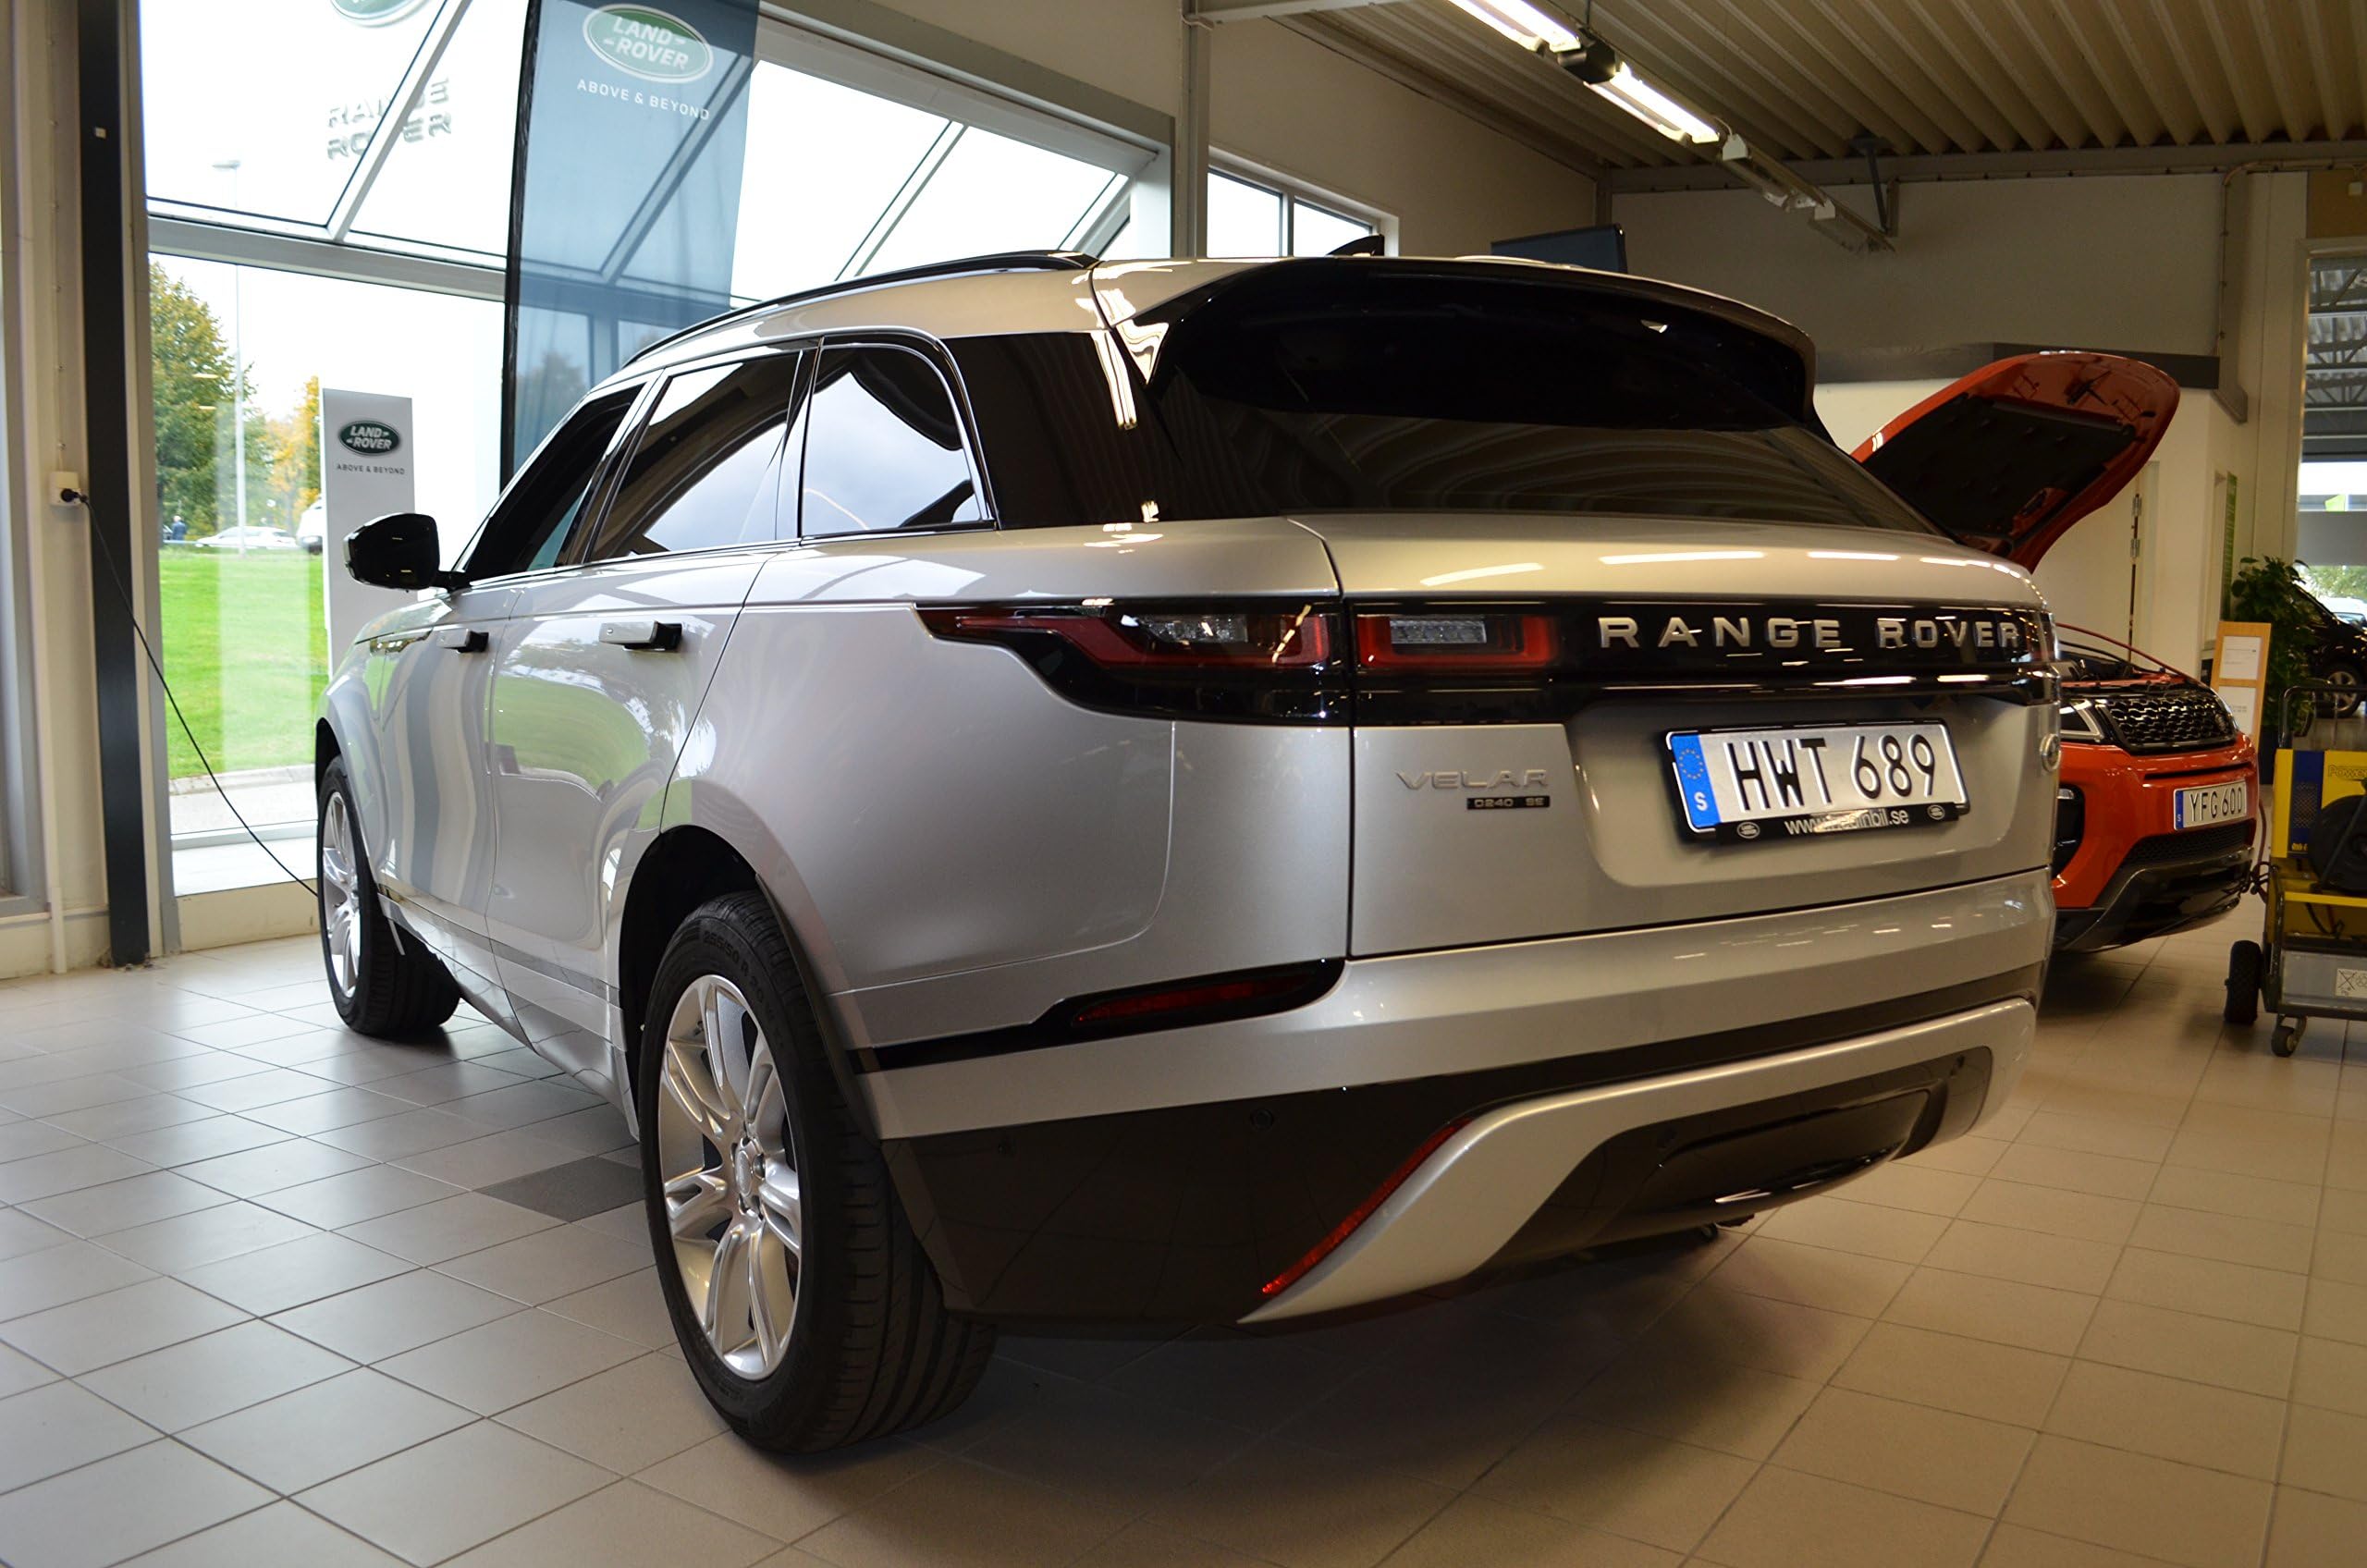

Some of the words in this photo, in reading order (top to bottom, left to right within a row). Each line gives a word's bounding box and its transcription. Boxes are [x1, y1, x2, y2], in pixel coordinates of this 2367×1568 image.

[577, 79, 630, 101] ABOVE
[634, 92, 644, 104] &
[649, 95, 710, 120] BEYOND
[327, 111, 452, 160] ROER
[337, 462, 363, 472] ABOVE
[365, 464, 372, 473] &
[373, 465, 406, 476] BEYOND
[1597, 616, 1843, 648] RANGE
[1875, 619, 2020, 649] ROVER
[1394, 768, 1550, 790] VELAR
[1723, 736, 1833, 813] HWT
[1850, 733, 1936, 801] 689
[1693, 791, 1709, 812] S
[2189, 790, 2218, 823] YFG
